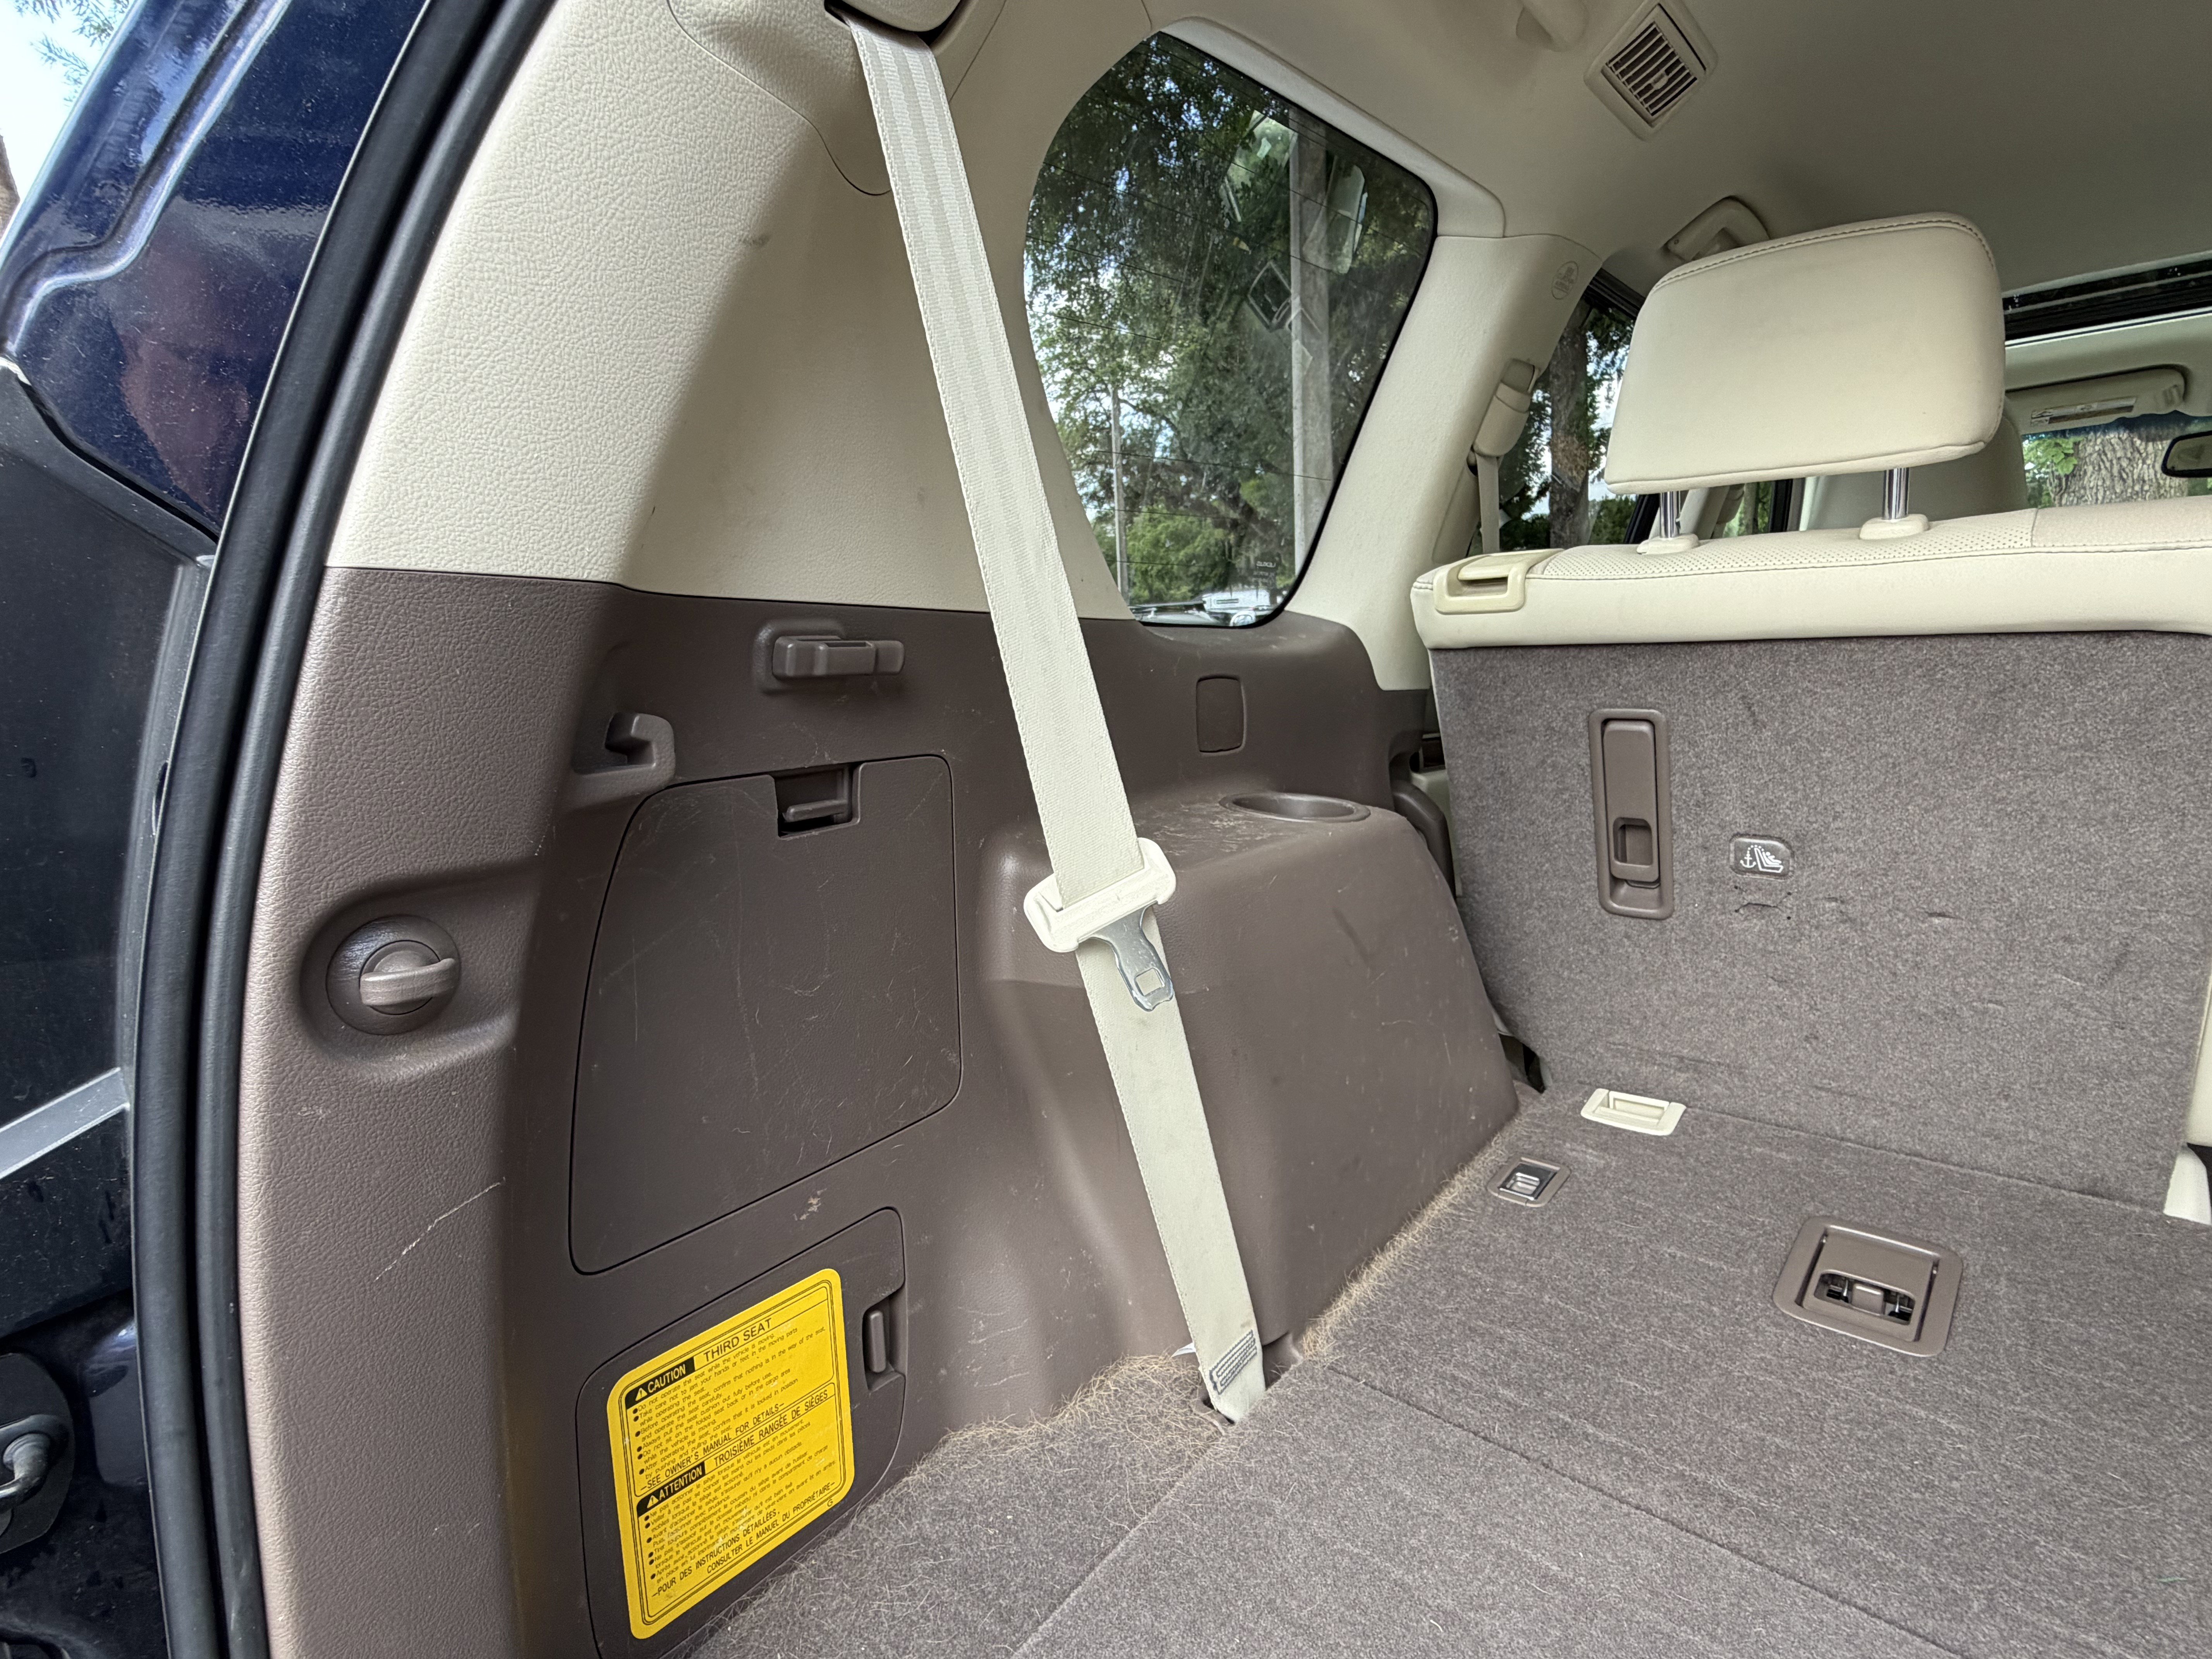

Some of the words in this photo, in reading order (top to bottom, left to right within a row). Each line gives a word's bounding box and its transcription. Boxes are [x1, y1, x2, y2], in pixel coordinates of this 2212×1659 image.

[704, 1336, 739, 1362] THIRD
[743, 1317, 771, 1341] SEAT
[647, 1364, 686, 1393] CAUTION
[714, 1431, 754, 1467] TROISIÈME
[759, 1414, 788, 1440] RANGÉE
[791, 1406, 800, 1420] DE
[804, 1385, 828, 1411] SIÈGES
[665, 1451, 699, 1480] OWNER'S
[703, 1433, 732, 1455] MANUAL
[735, 1421, 749, 1436] FOR
[659, 1465, 702, 1500] ATTENTION
[827, 1499, 833, 1507] G
[679, 1566, 692, 1581] DES
[696, 1534, 740, 1570] INSTRUCTIONS
[707, 1544, 743, 1574] CONSULTER
[745, 1536, 753, 1547] LE
[756, 1519, 779, 1540] MANUEL
[782, 1511, 790, 1522] DU
